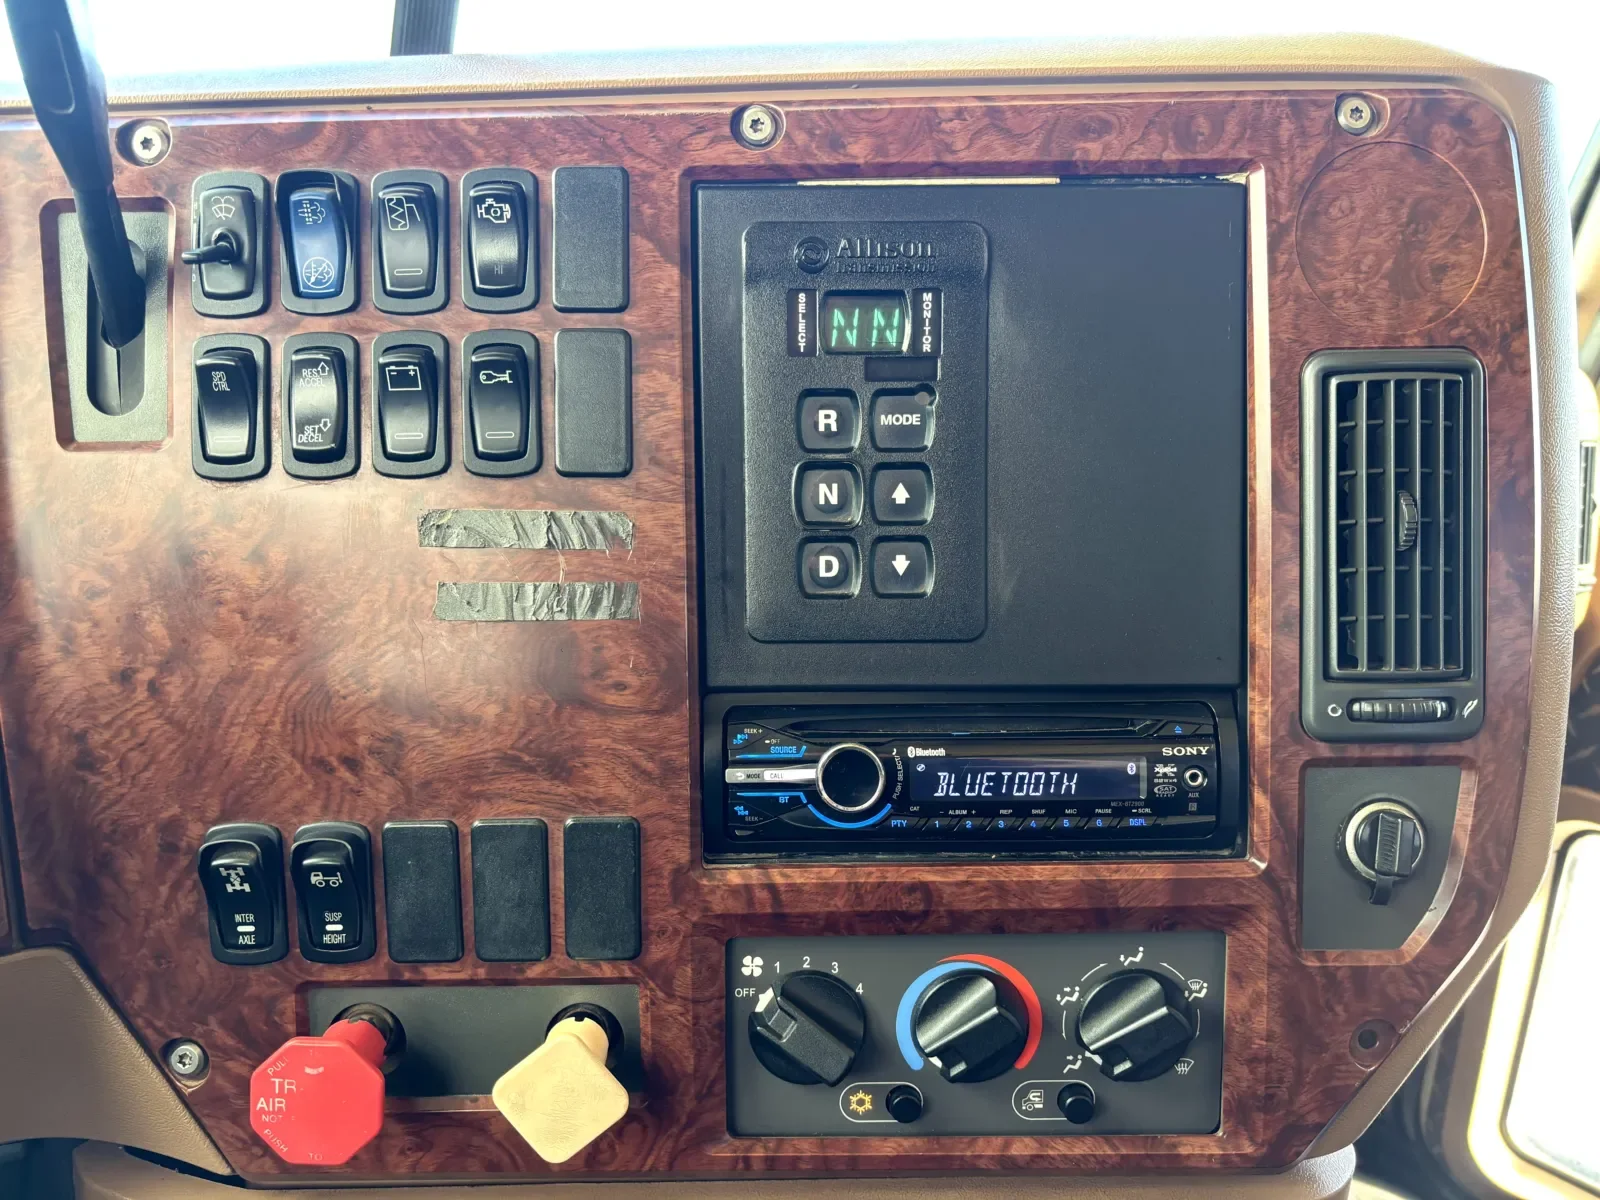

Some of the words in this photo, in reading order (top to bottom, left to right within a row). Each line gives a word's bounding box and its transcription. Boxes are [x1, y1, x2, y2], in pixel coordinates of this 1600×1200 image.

[494, 264, 504, 275] HI
[797, 293, 806, 353] SELECT
[923, 293, 932, 352] MONITOR
[212, 371, 226, 381] SPD
[212, 382, 230, 391] CTRL
[299, 378, 324, 387] ACCEL
[818, 409, 838, 432] R
[880, 414, 921, 425] MODE
[304, 425, 319, 434] SET
[298, 434, 323, 443] DECEL
[818, 483, 838, 505] N
[819, 555, 840, 578] D
[916, 748, 946, 757] Bluetooth
[1162, 746, 1209, 756] SONY
[933, 771, 1079, 797] BLUETOOTH
[934, 820, 939, 828] 1
[965, 820, 972, 828] 2
[998, 820, 1004, 828] 3
[1030, 820, 1036, 828] 4
[1063, 819, 1070, 827] 5
[1096, 819, 1102, 827] 6
[1129, 818, 1147, 826] DSPL
[234, 913, 255, 923] INTER
[324, 912, 342, 922] SUSP
[238, 935, 256, 944] AXLE
[323, 934, 346, 944] HEIGHT
[774, 961, 780, 973] 1
[802, 956, 811, 968] 2
[831, 962, 839, 973] 3
[734, 988, 756, 997] OFF
[855, 983, 863, 995] 4
[256, 1097, 286, 1112] AIR
[264, 1129, 289, 1153] PUSH
